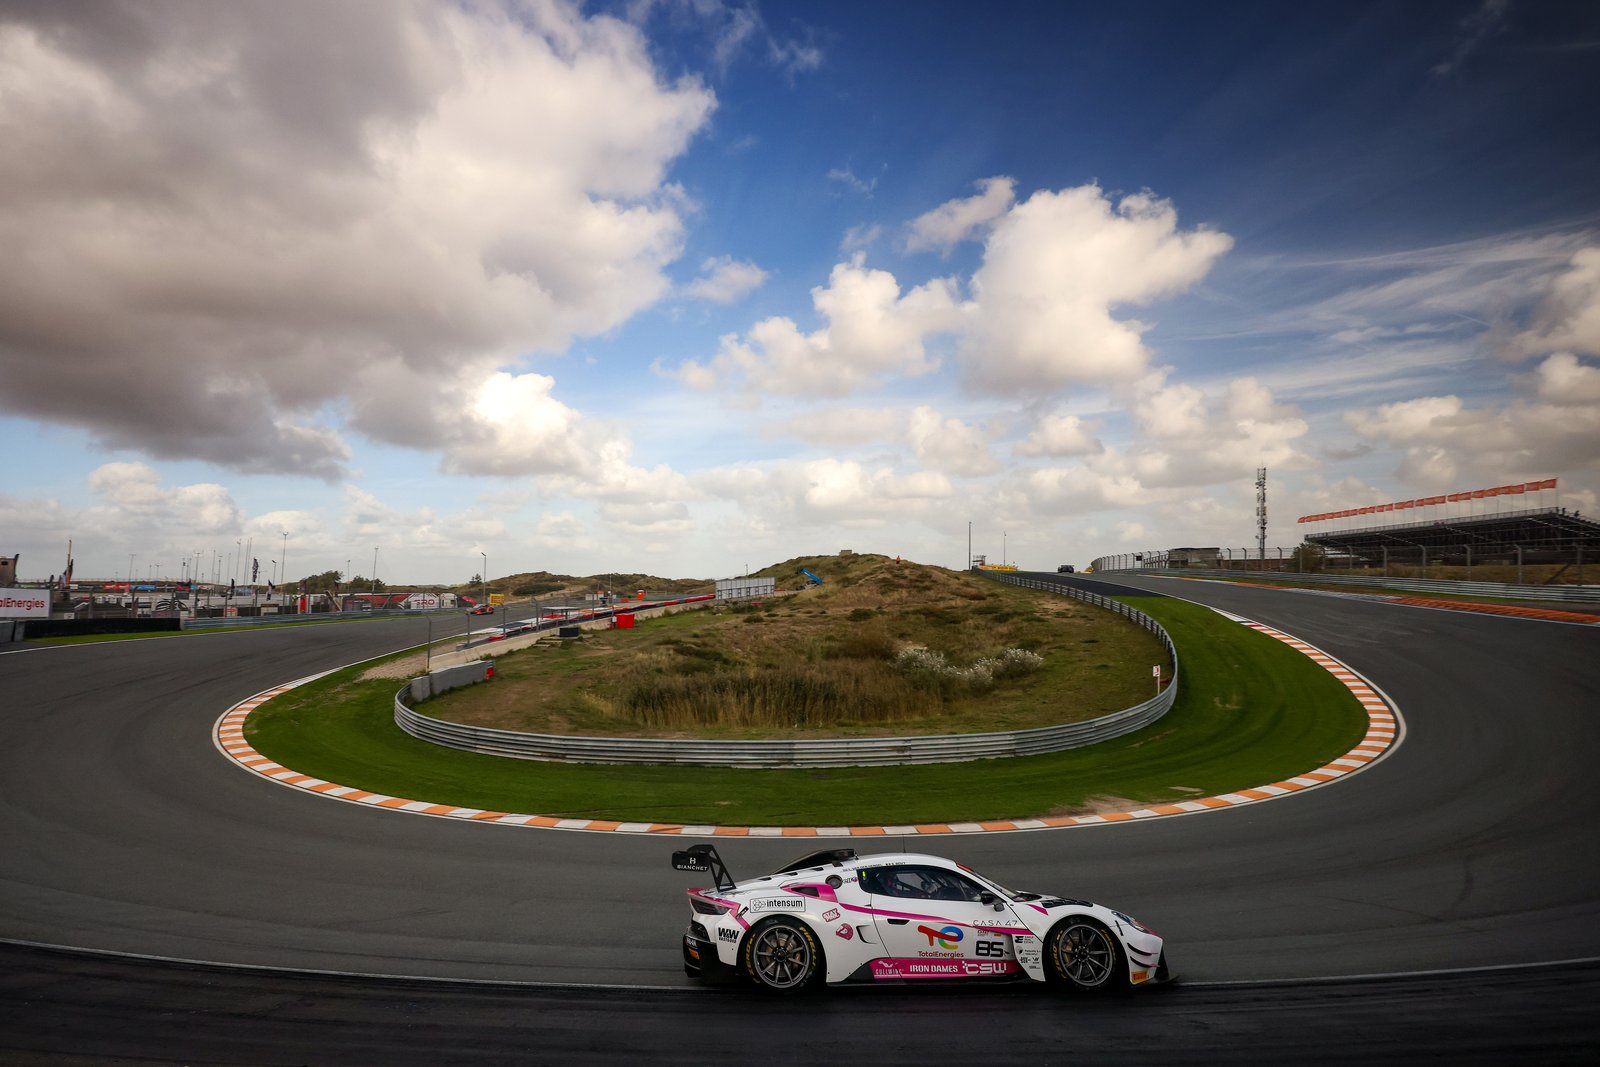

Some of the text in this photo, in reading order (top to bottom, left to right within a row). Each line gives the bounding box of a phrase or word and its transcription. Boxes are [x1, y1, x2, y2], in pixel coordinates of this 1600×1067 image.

[766, 899, 803, 908] intensum
[972, 919, 1018, 927] CASA 47
[718, 927, 739, 939] W&W
[975, 940, 1005, 958] 85
[918, 950, 964, 959] TotalEnergies
[909, 965, 958, 973] IRON DAMES
[963, 962, 1007, 975] CSW
